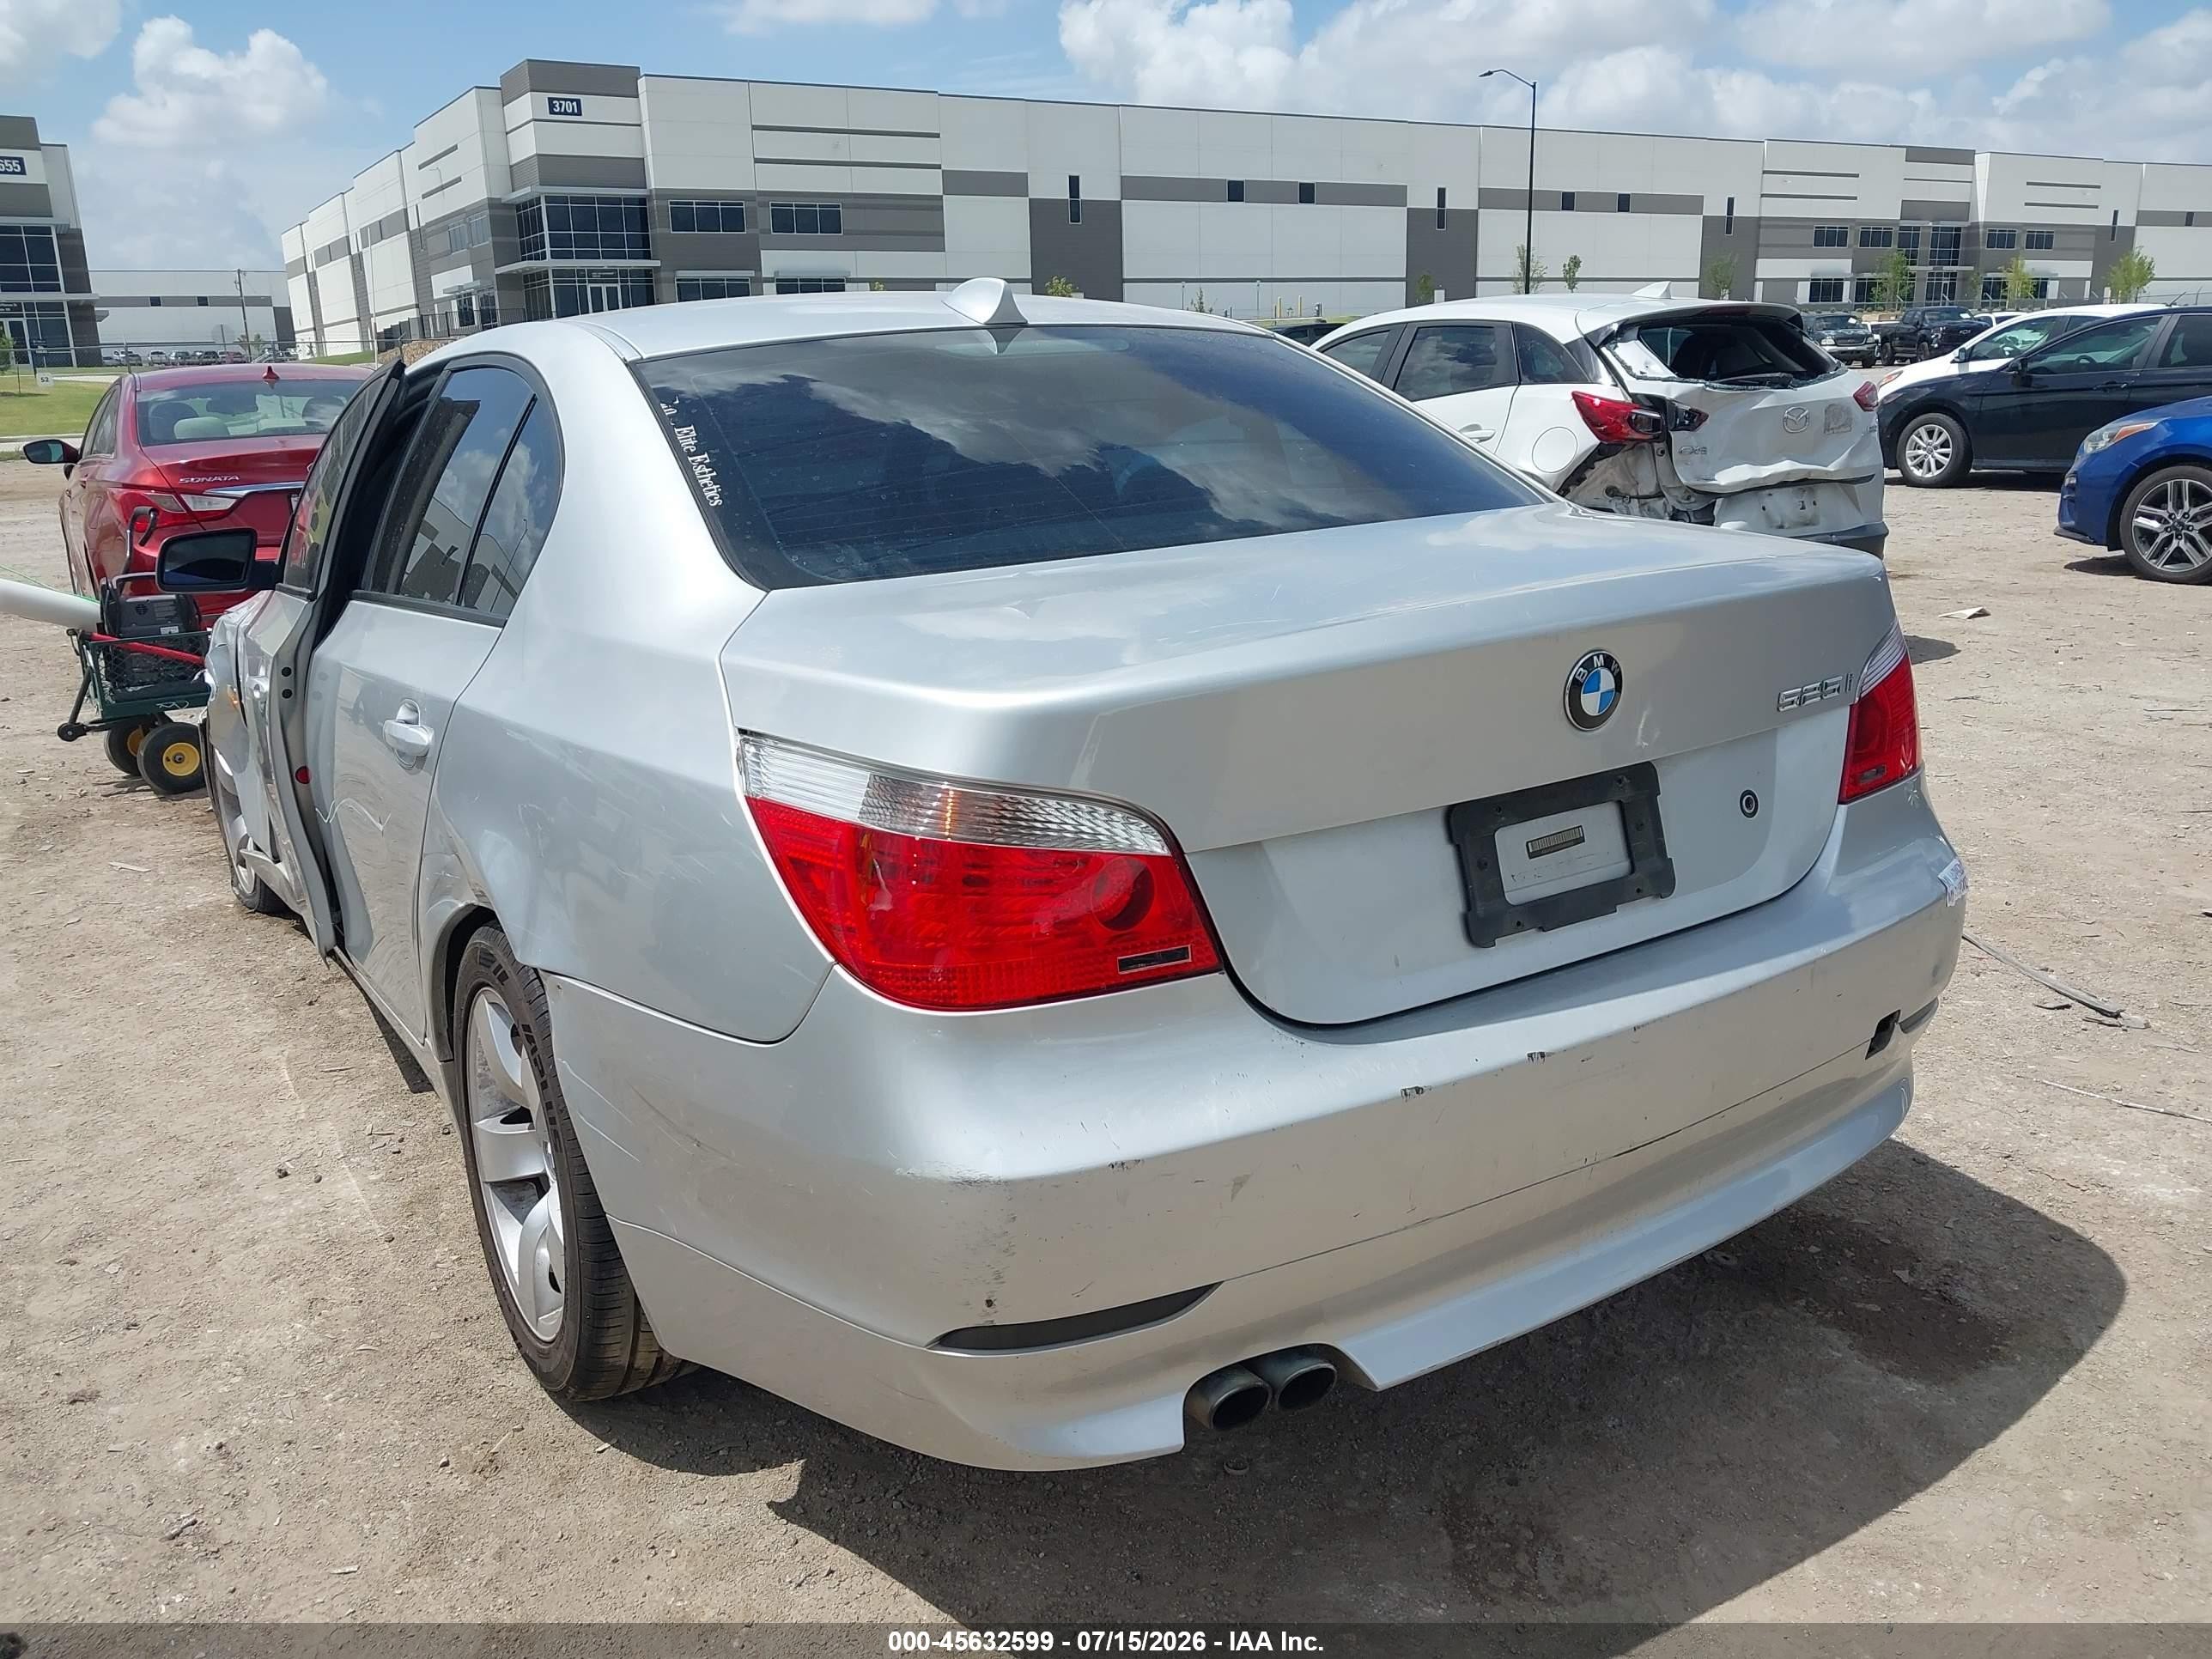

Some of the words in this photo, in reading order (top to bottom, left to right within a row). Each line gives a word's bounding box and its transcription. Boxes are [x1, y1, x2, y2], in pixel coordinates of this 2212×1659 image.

[552, 100, 578, 113] 3701
[179, 475, 240, 484] SONATA
[674, 424, 699, 453] Elite
[687, 452, 723, 507] Esthetics
[1575, 654, 1620, 684] BMW
[1777, 673, 1854, 712] 525i
